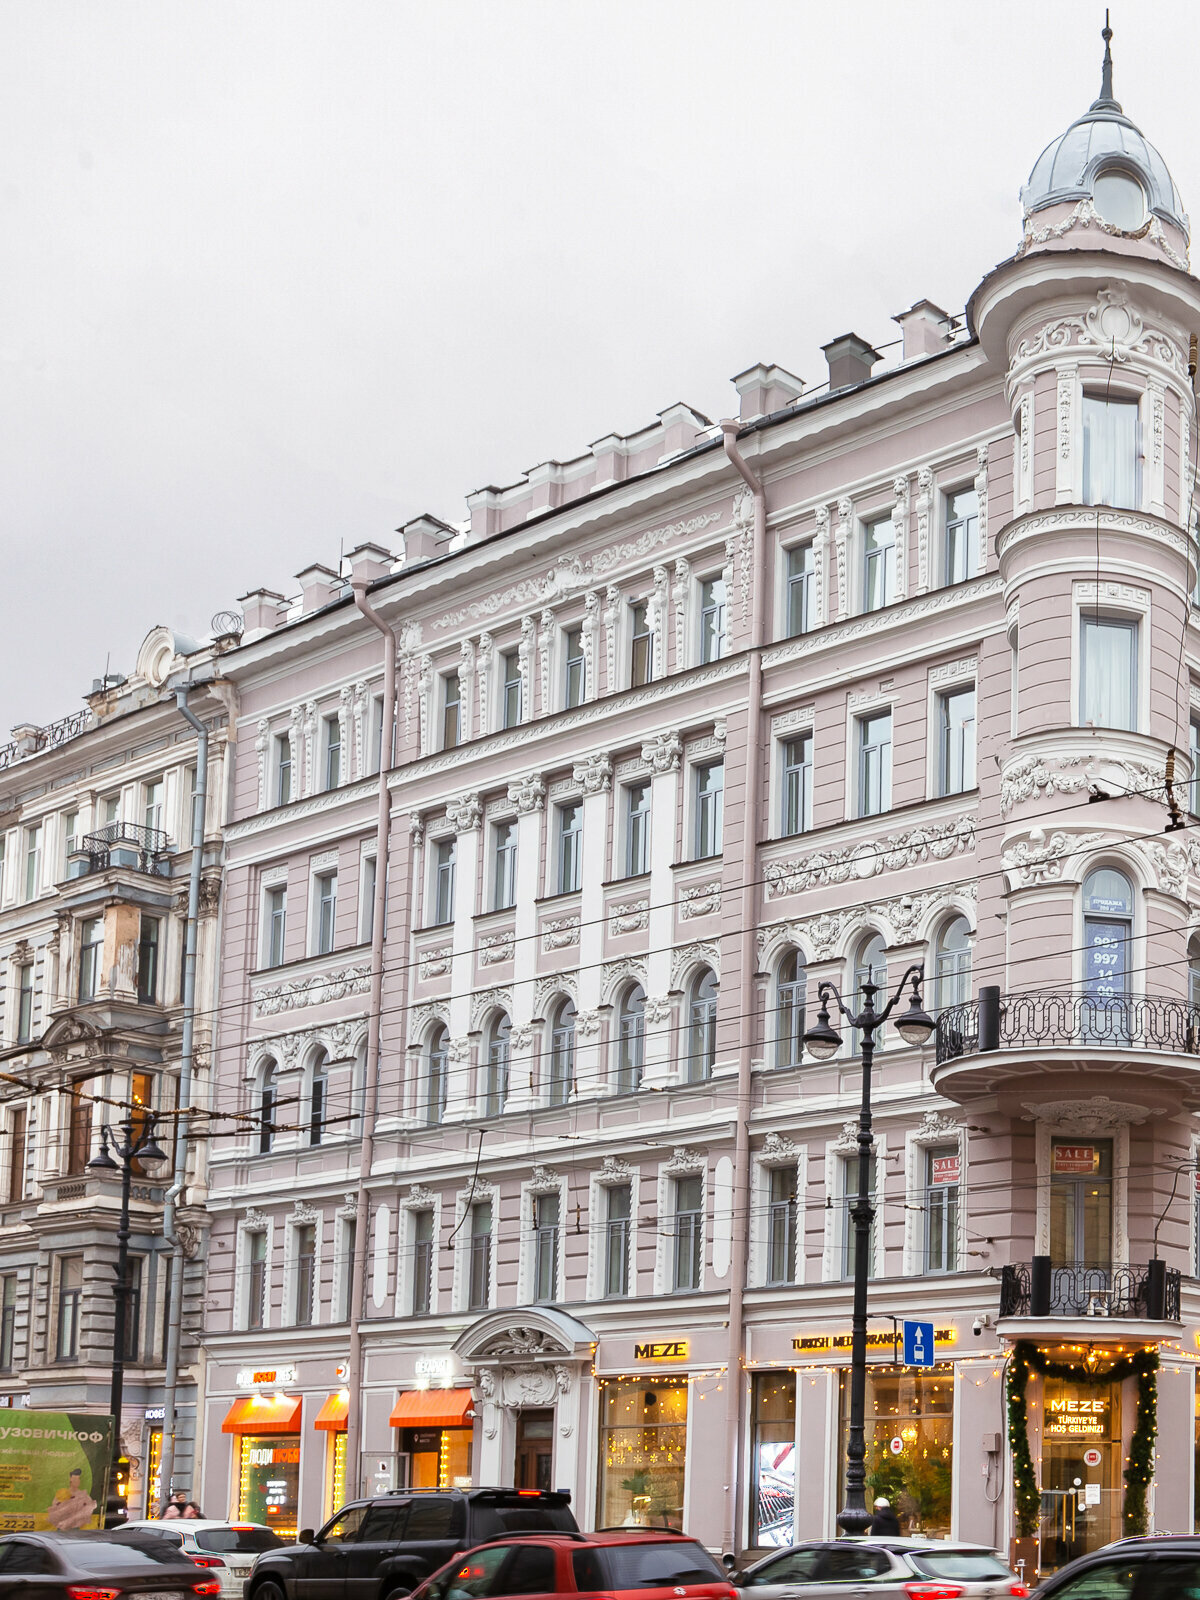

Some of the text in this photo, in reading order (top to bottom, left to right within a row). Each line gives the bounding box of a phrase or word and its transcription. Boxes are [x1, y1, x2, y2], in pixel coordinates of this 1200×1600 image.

[1093, 952, 1118, 965] 997
[1098, 969, 1113, 981] 14
[1056, 1149, 1091, 1158] SALE
[934, 1158, 960, 1170] SALE
[790, 1337, 830, 1350] TURKISH
[634, 1342, 686, 1359] MEZE
[1051, 1400, 1104, 1412] MEZE
[1050, 1425, 1067, 1434] HOŞ
